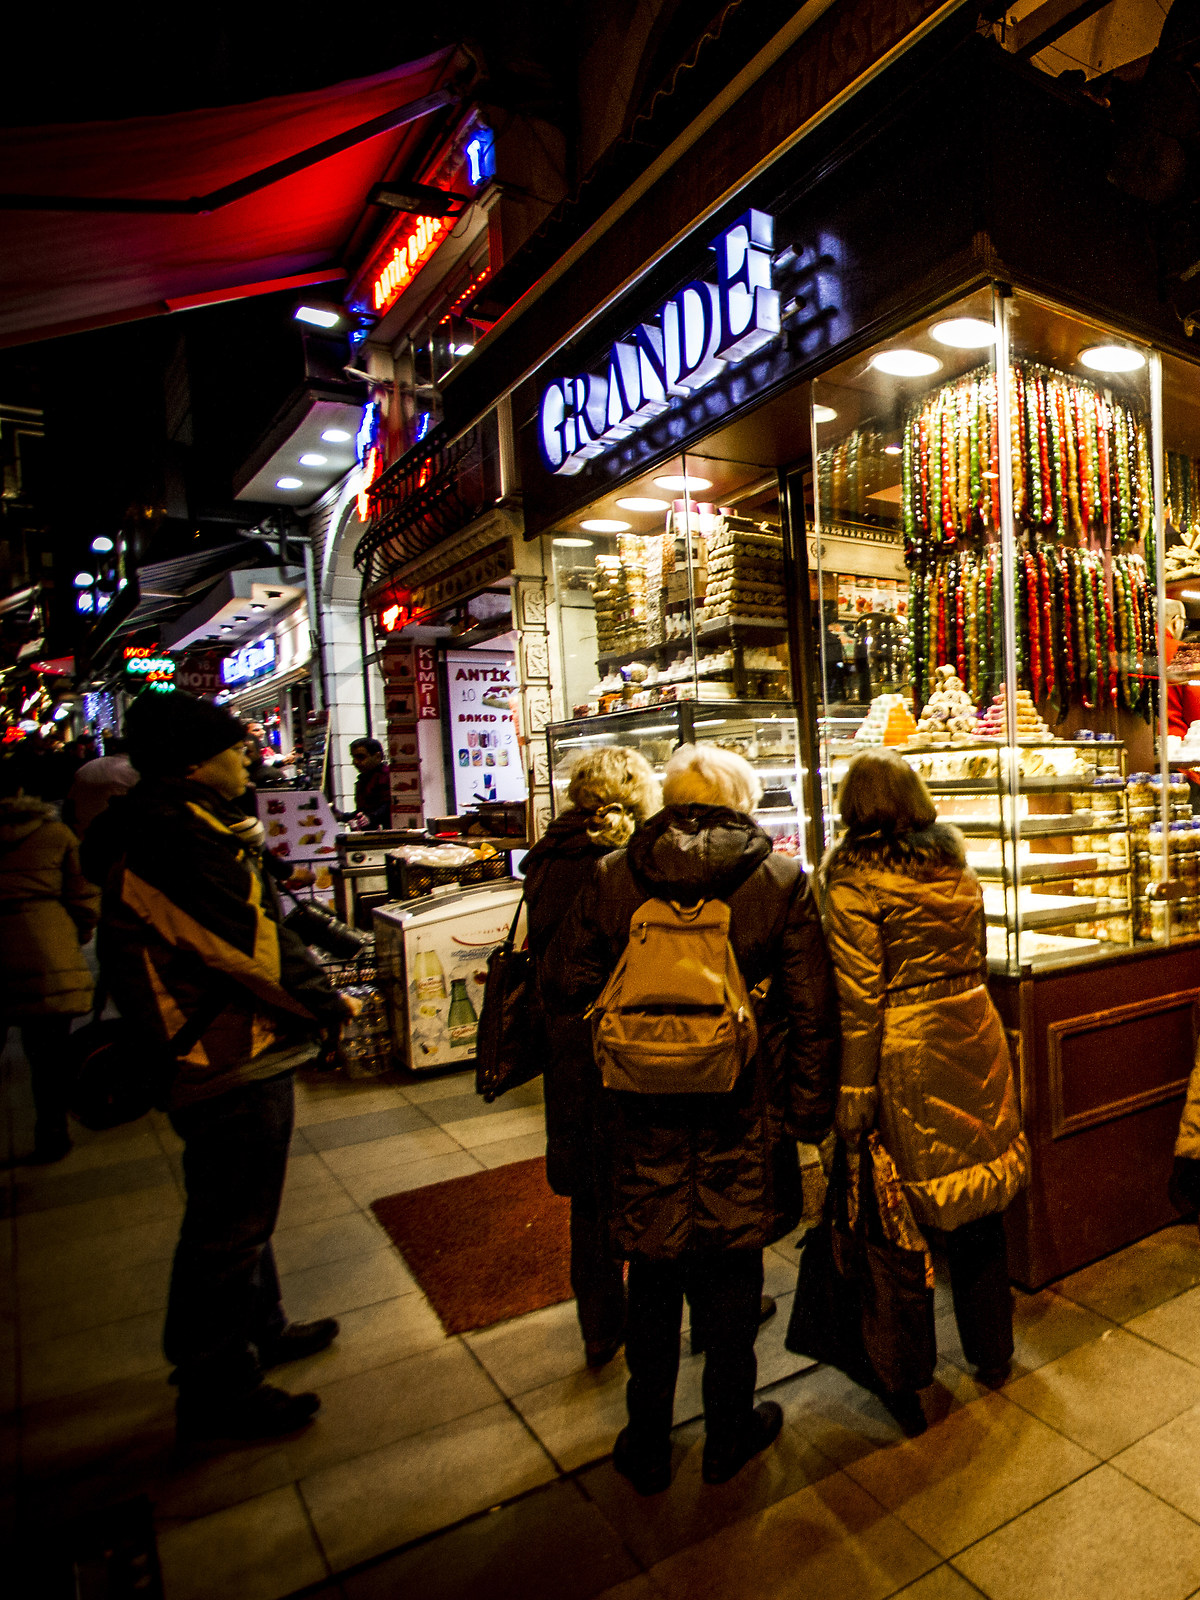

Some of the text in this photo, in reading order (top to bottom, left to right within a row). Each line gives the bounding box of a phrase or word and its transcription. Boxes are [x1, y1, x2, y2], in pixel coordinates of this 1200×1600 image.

[538, 208, 779, 475] GRANDE
[455, 667, 511, 682] ANTİK
[458, 713, 496, 723] BAKED
